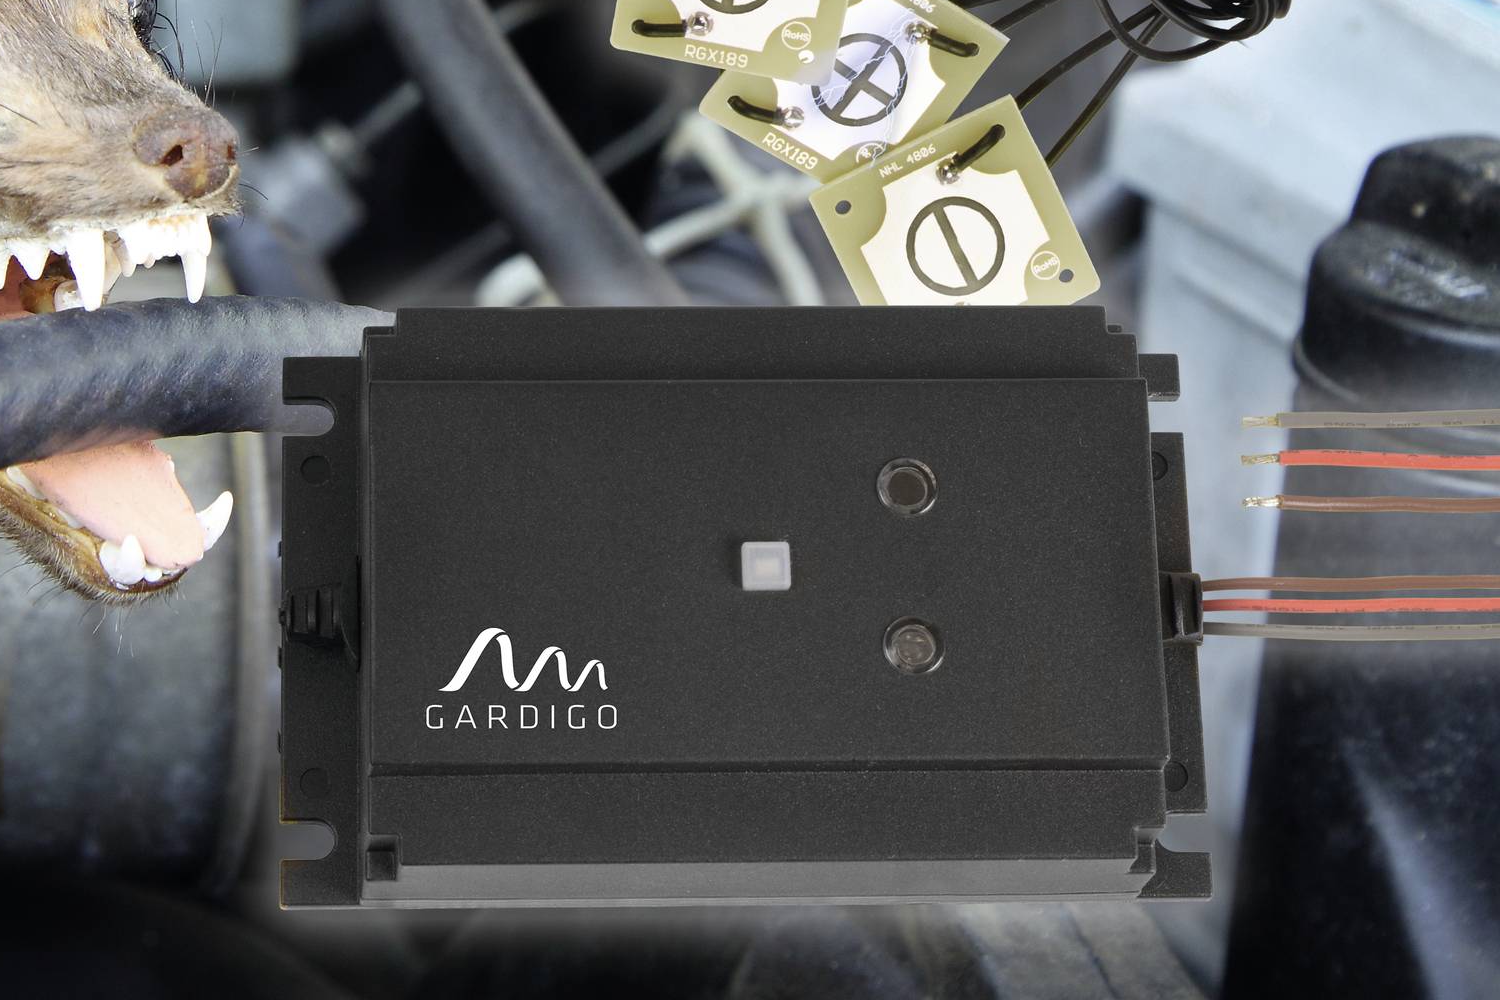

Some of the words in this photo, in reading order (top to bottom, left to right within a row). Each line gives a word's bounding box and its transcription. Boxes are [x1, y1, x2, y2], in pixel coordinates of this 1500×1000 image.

[684, 43, 749, 69] RGX189
[762, 131, 819, 170] RGX189
[878, 161, 904, 179] NHL
[906, 143, 937, 164] 4806
[425, 704, 618, 730] GARDIGO
